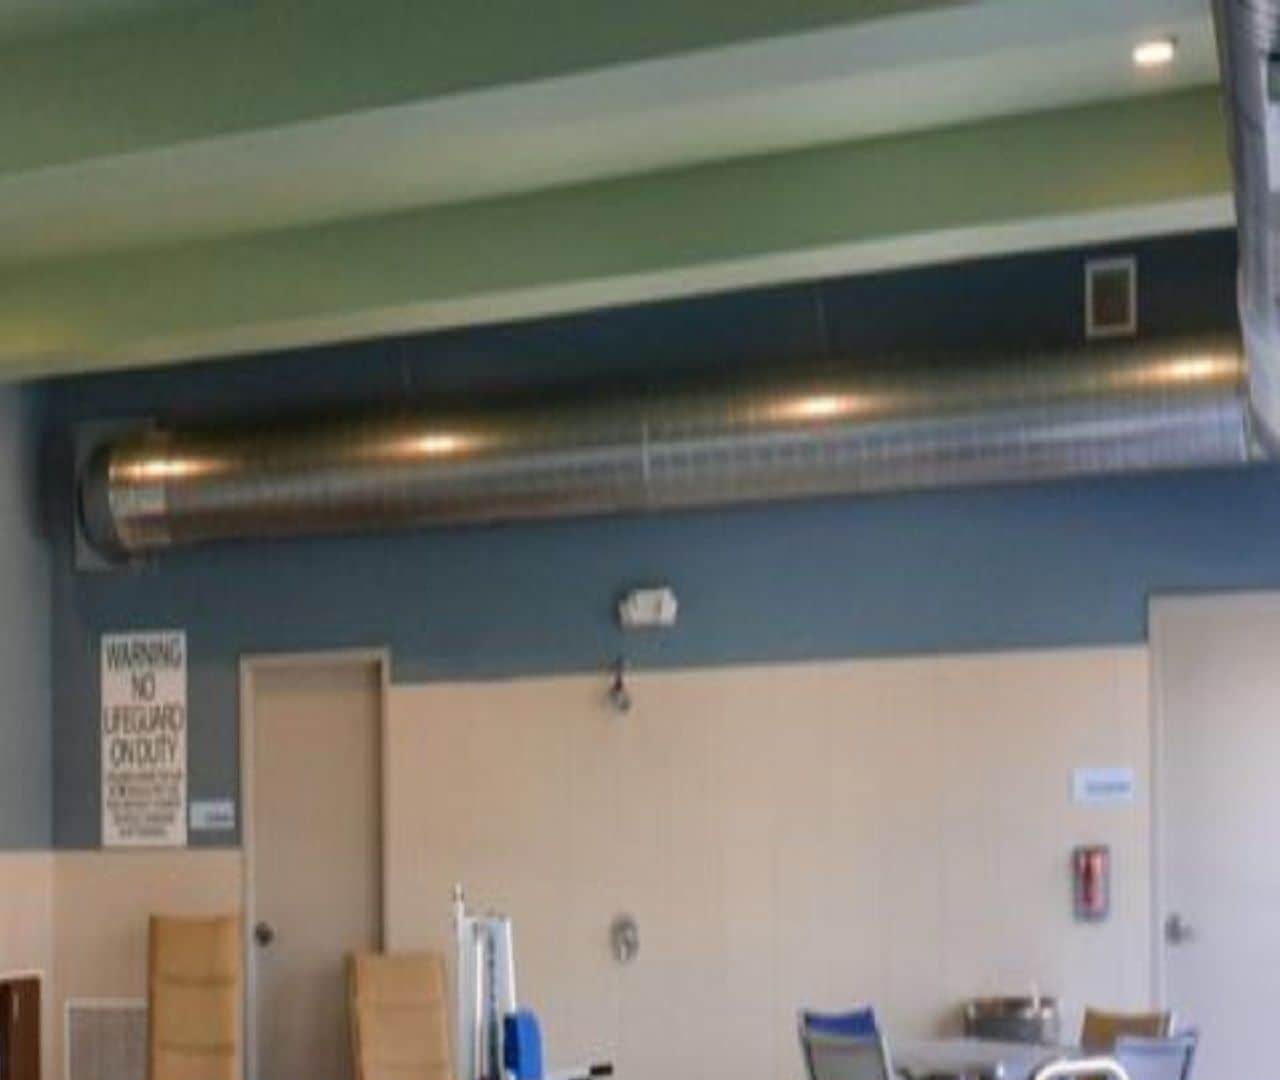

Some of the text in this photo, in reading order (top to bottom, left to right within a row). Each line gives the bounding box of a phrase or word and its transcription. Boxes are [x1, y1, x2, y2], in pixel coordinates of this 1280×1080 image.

[105, 636, 183, 672] WARNING
[130, 671, 156, 702] NO
[103, 702, 183, 736] LIFEGUARD
[111, 732, 177, 768] ON DUTY
